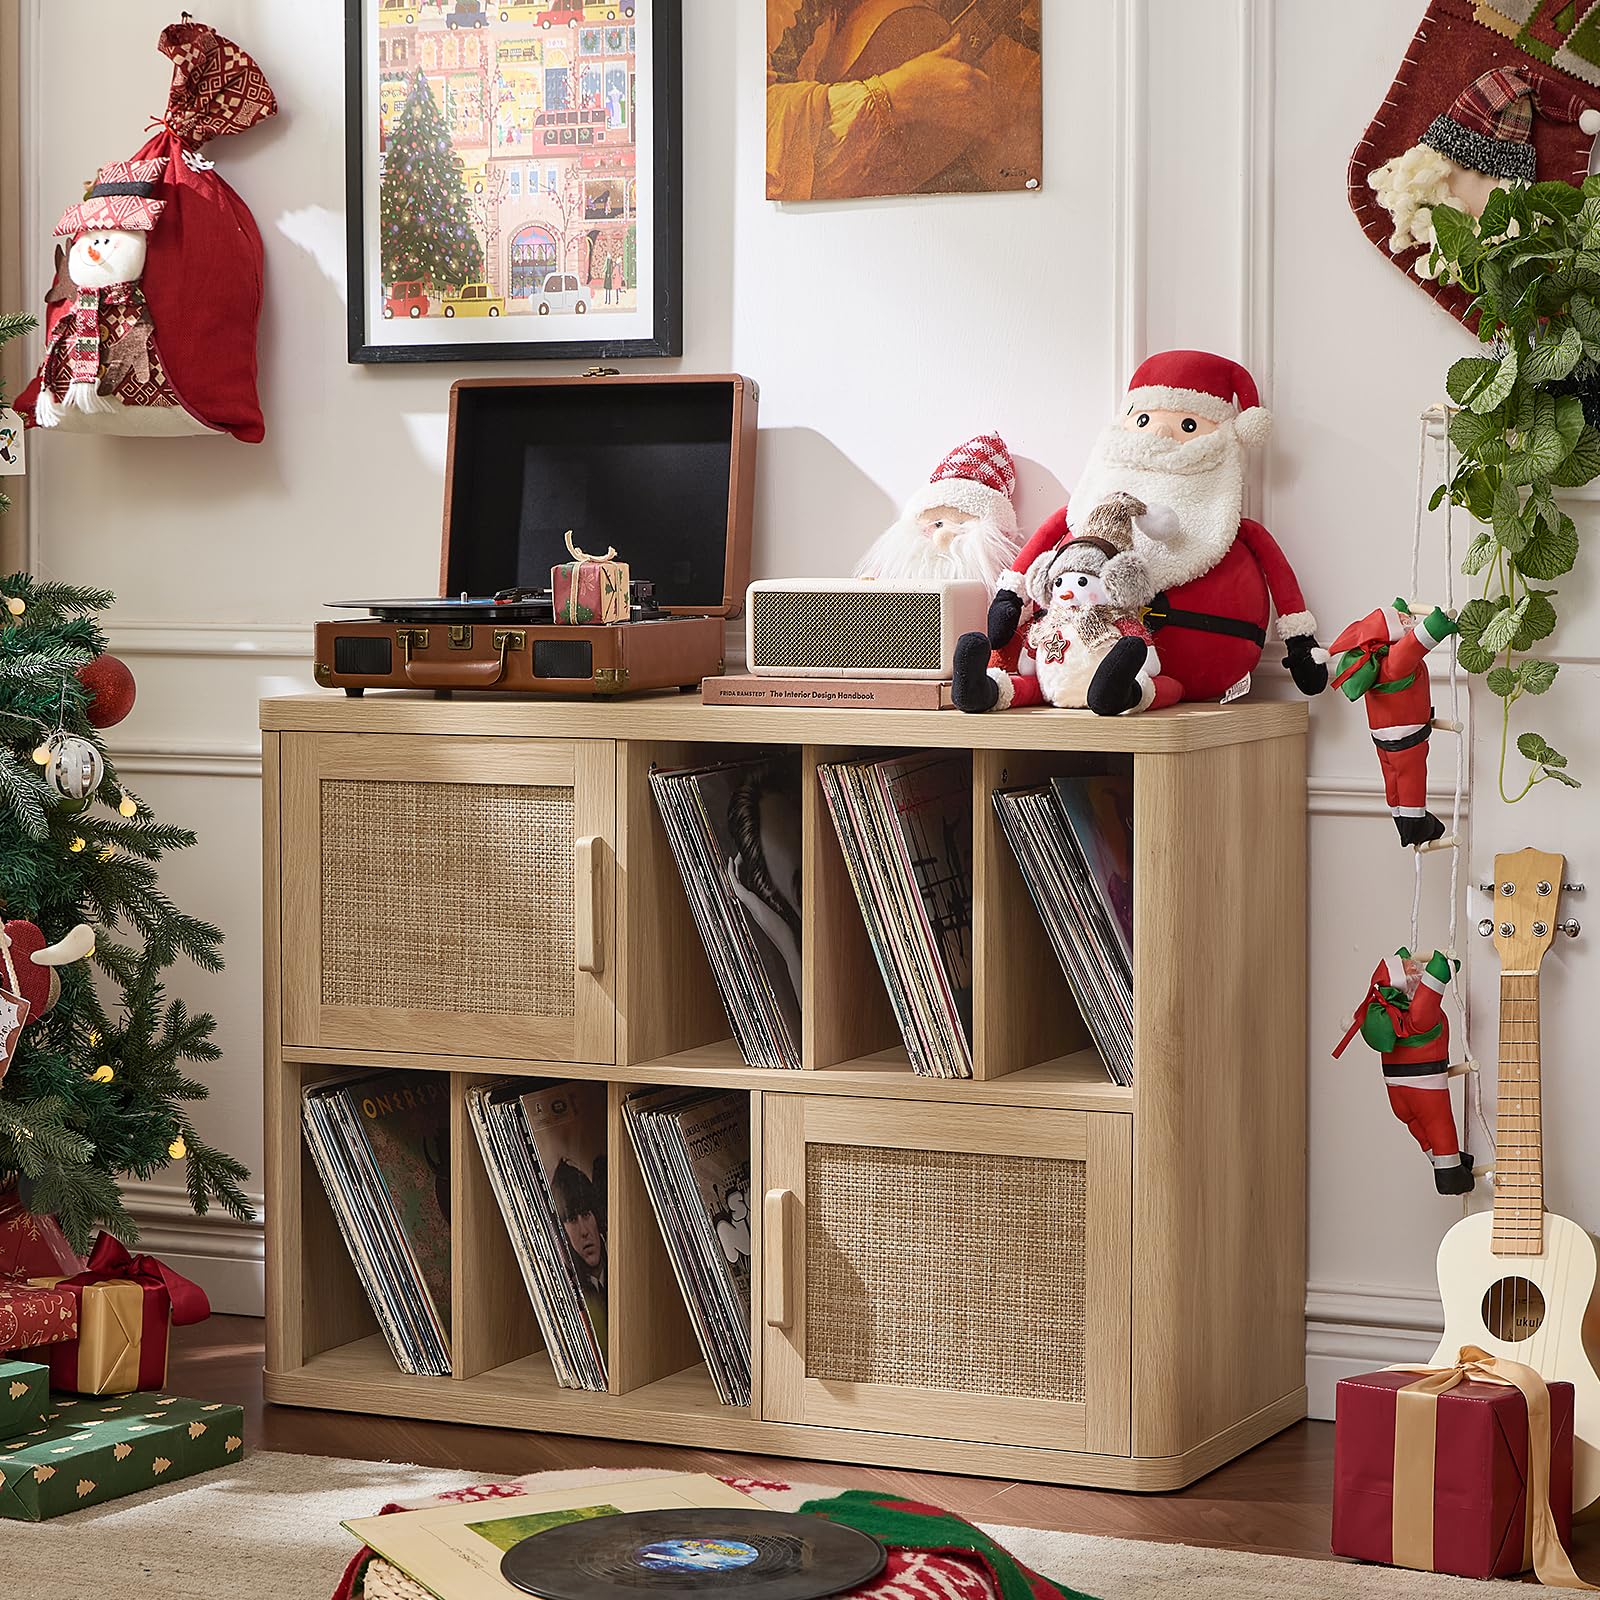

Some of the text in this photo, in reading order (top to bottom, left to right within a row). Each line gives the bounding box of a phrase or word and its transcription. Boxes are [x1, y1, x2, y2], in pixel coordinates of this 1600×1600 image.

[770, 690, 875, 700] The Interior Design Handbook
